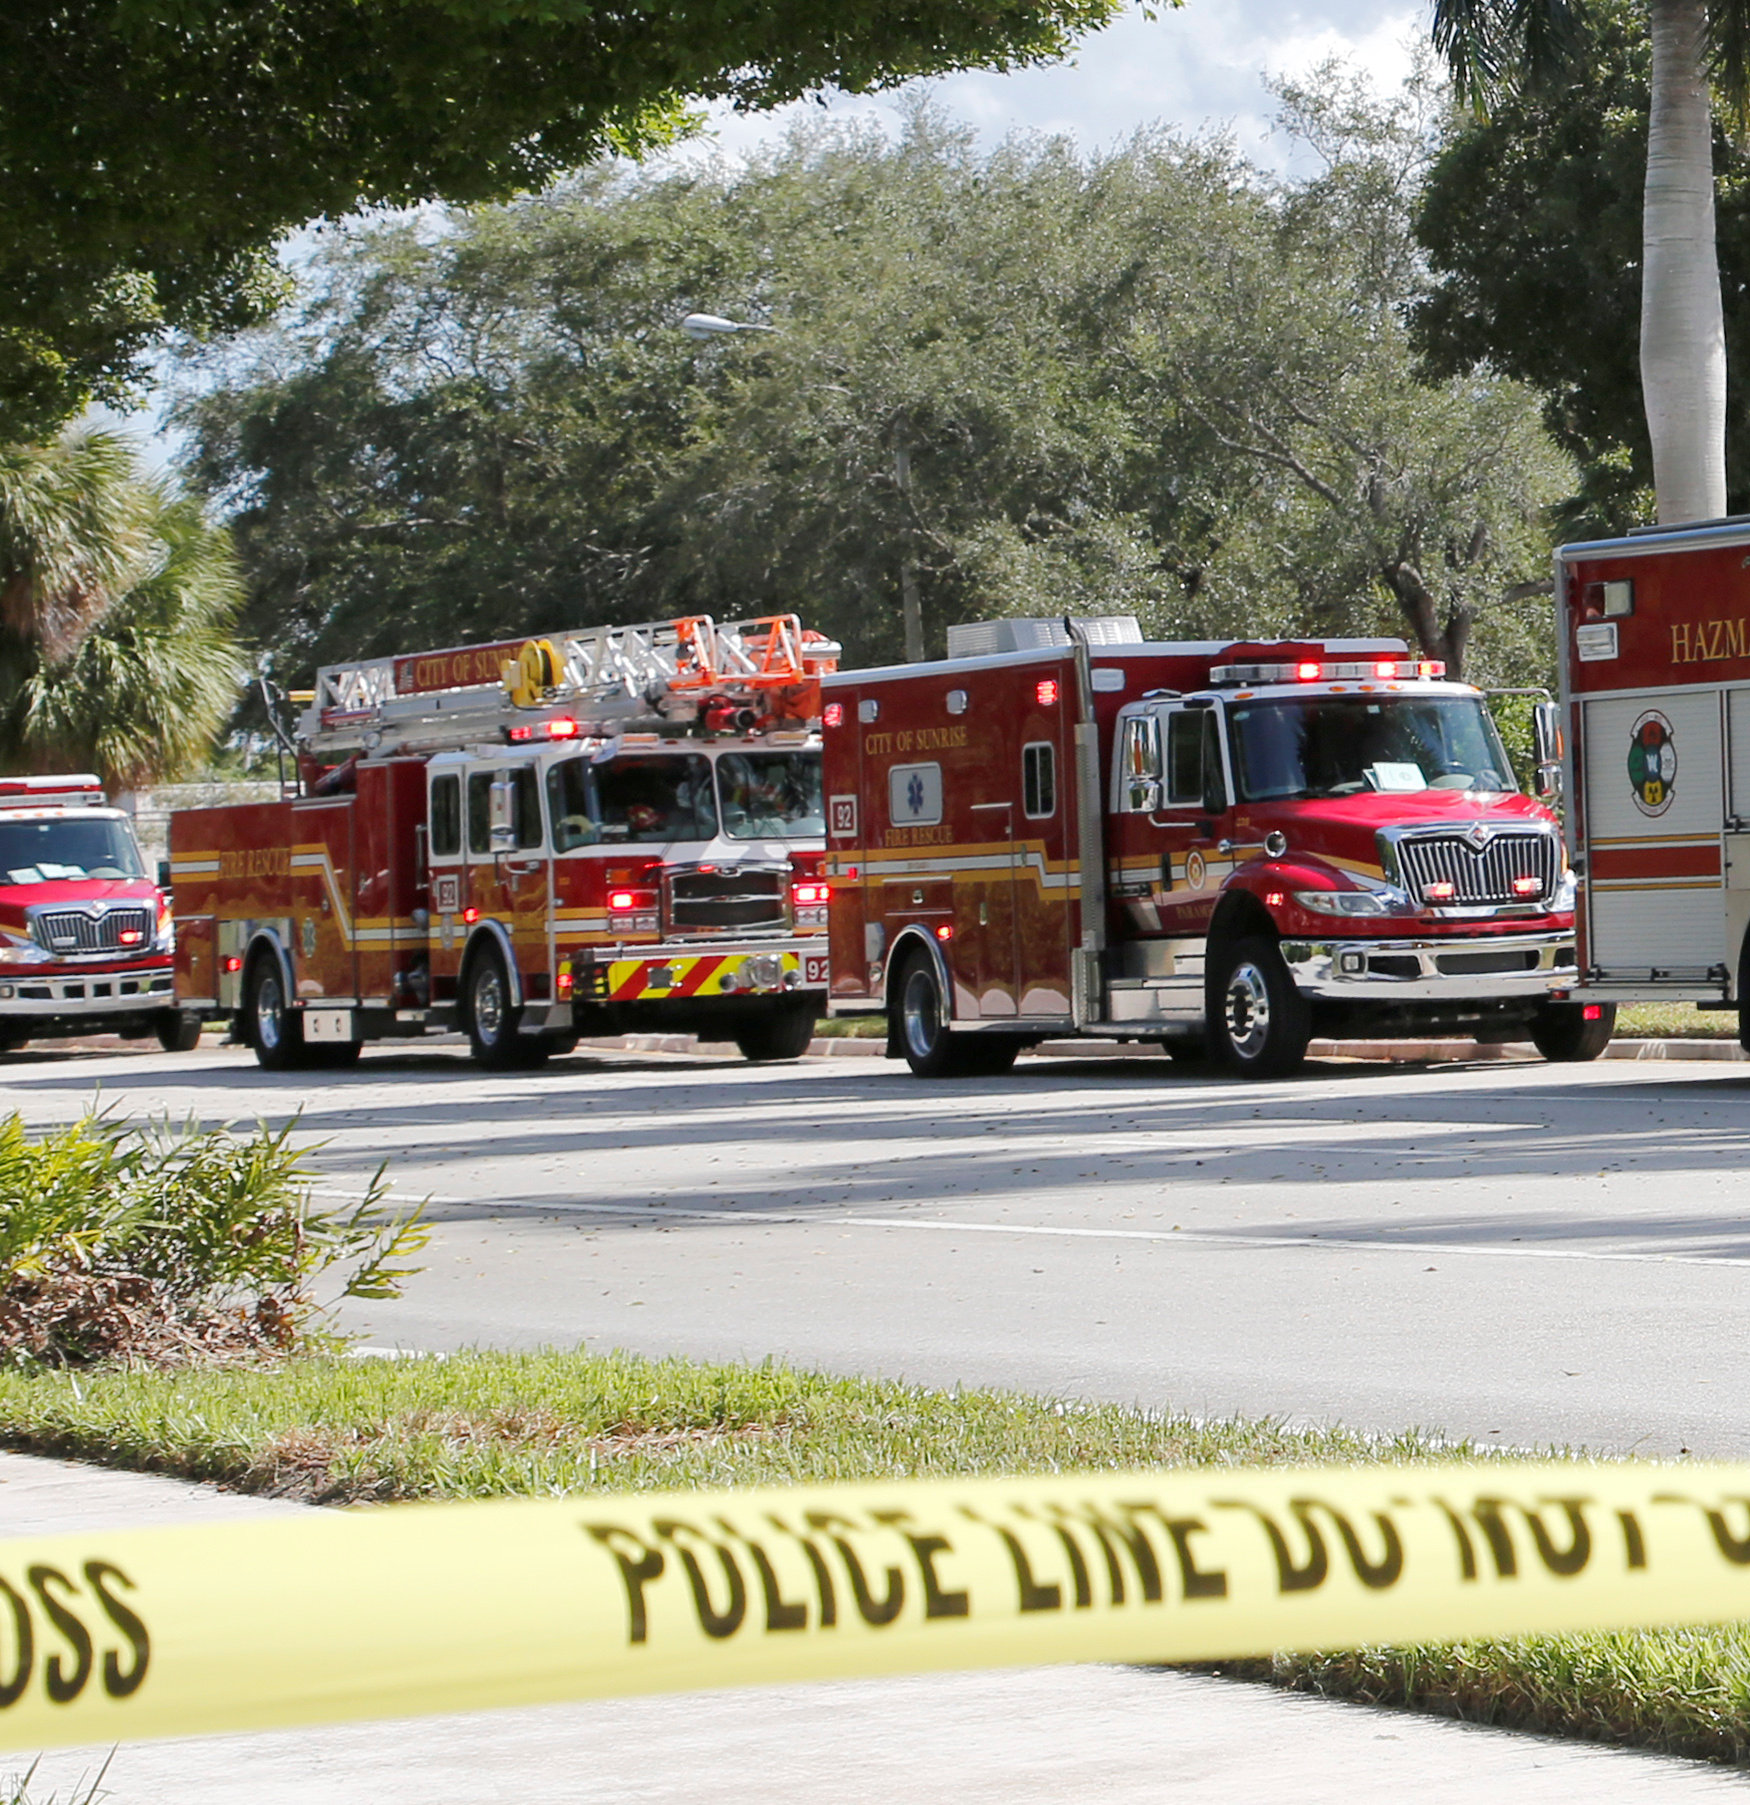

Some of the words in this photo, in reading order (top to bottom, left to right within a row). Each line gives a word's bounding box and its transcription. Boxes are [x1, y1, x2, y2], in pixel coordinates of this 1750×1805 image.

[417, 658, 449, 688] CITY
[452, 654, 471, 682] OF
[866, 732, 892, 755] CITY
[897, 730, 913, 751] OF
[916, 725, 967, 750] SUNRISE
[836, 805, 852, 828] 92
[885, 827, 908, 848] FIRE
[912, 825, 953, 845] RESCUE
[807, 960, 829, 980] 92
[582, 1510, 970, 1646] POLICE
[957, 1500, 1229, 1614] LINE
